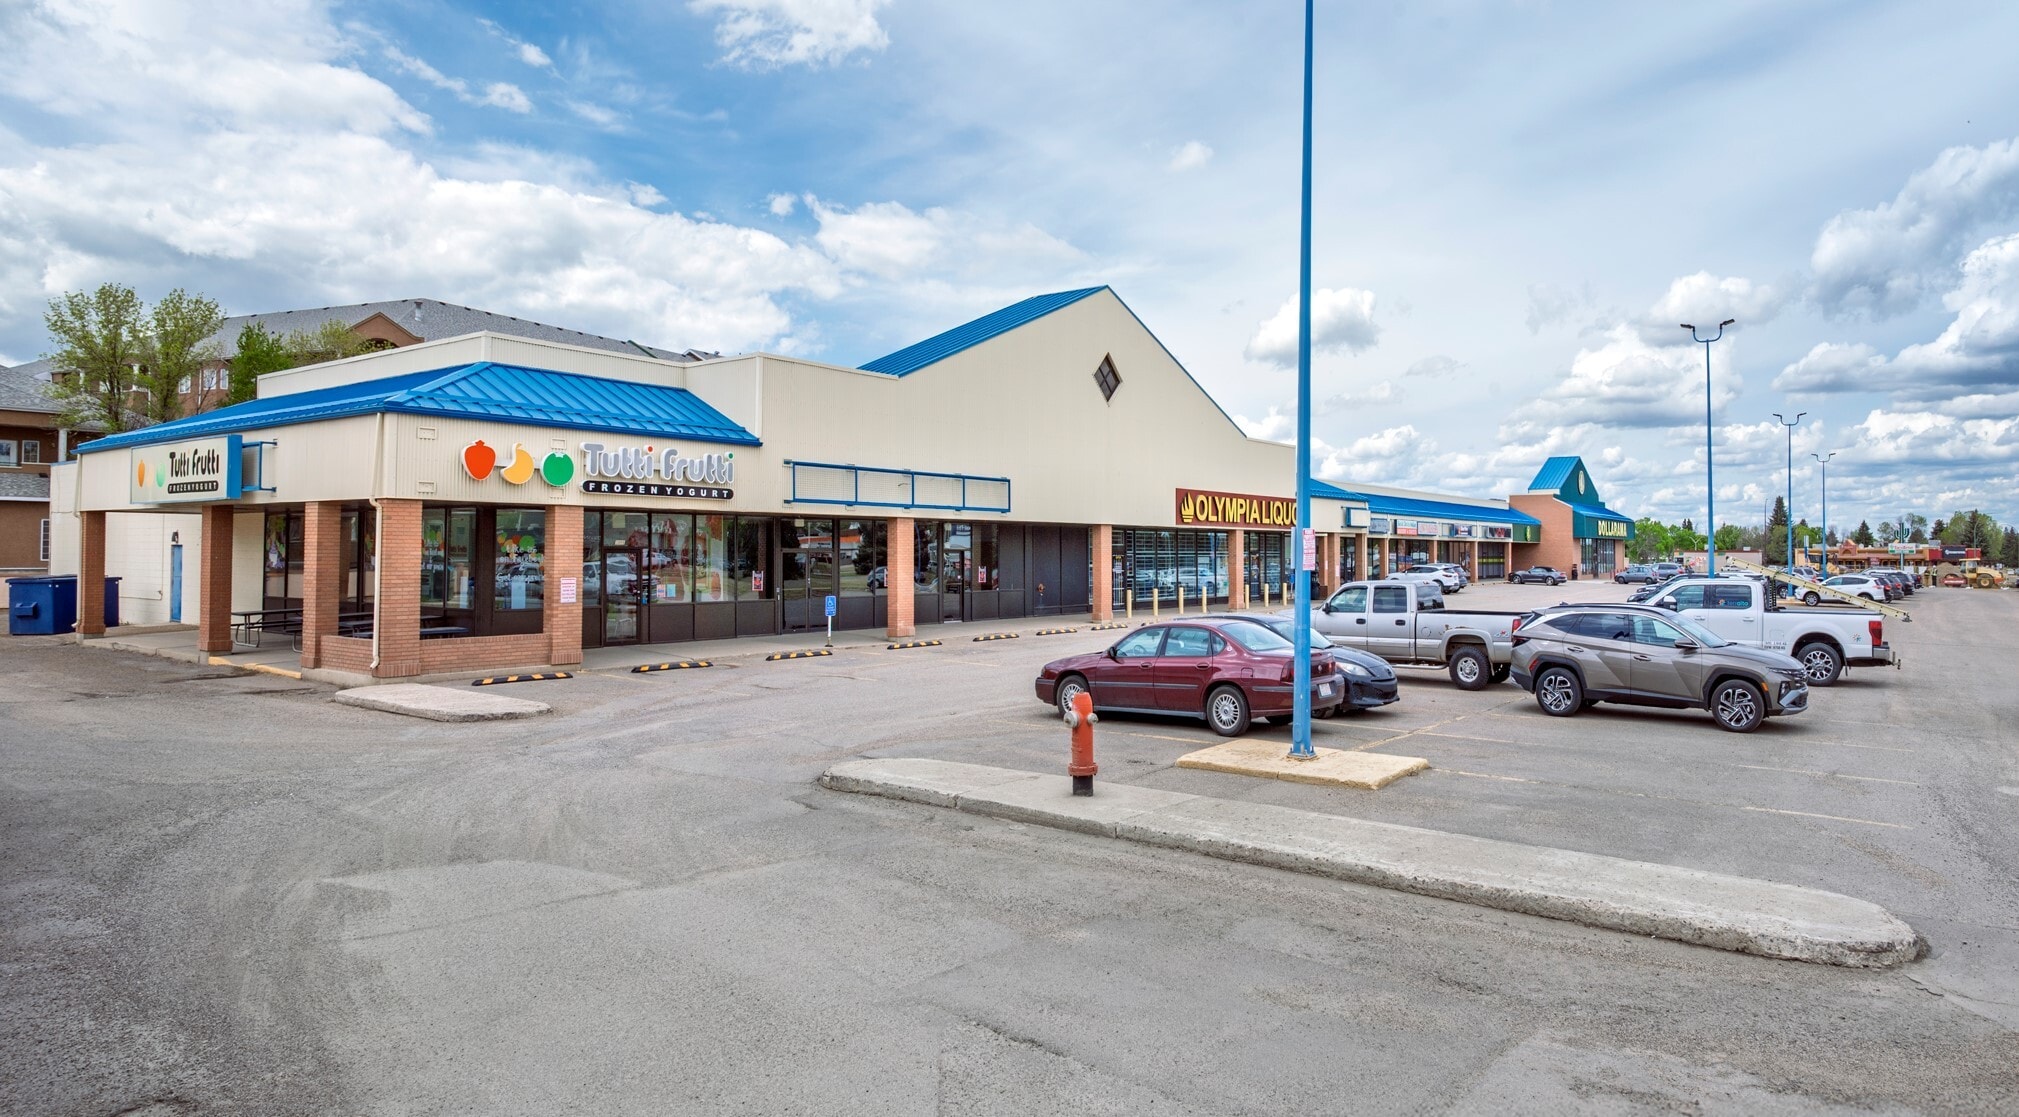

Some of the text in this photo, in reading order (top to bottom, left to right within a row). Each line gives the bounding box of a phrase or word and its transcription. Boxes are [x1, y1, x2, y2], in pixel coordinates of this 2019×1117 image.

[169, 448, 190, 477] Tutti
[584, 442, 654, 479] Tutti
[588, 482, 729, 498] FROZEN YOGURT
[1195, 494, 1261, 524] OLYMPIA
[1598, 520, 1628, 537] DOLLARAMA
